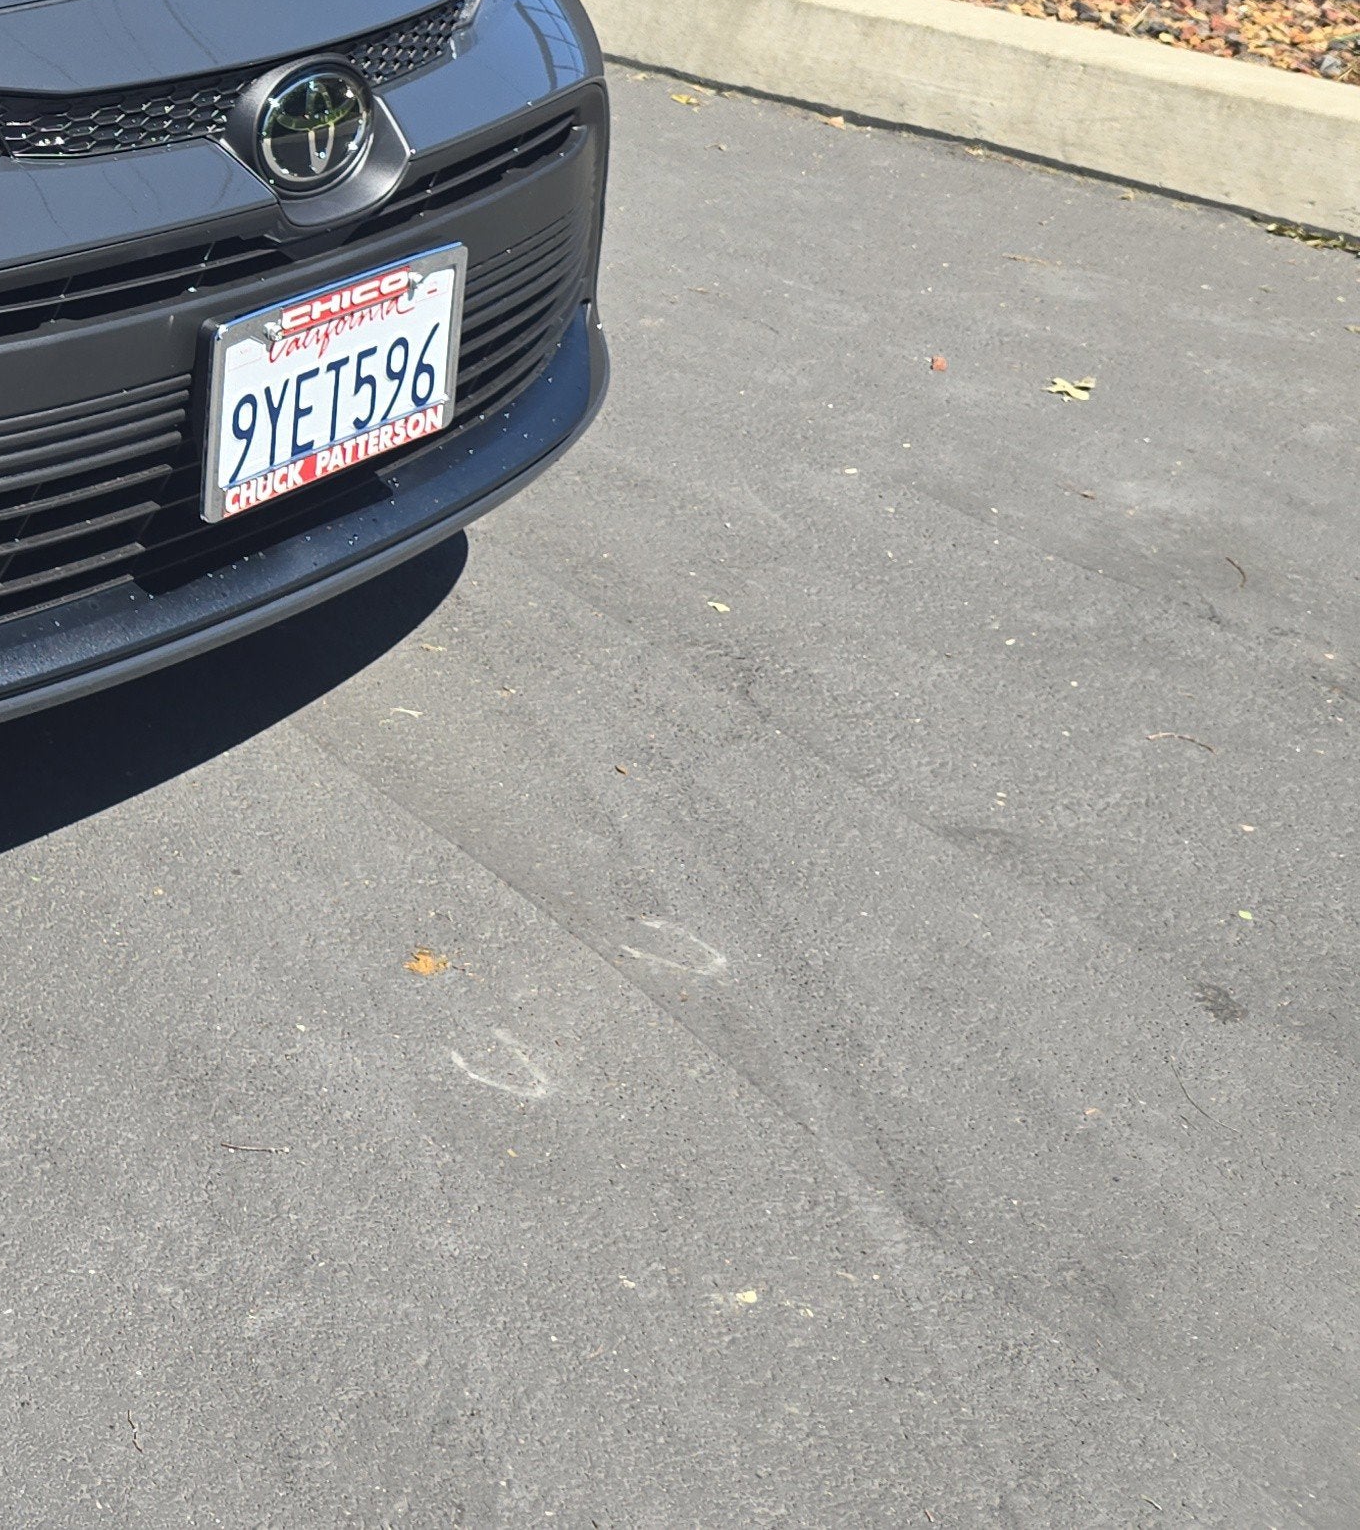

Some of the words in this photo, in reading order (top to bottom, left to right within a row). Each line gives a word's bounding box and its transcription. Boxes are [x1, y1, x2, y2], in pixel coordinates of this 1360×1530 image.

[269, 296, 415, 363] California
[281, 270, 411, 331] CHICO
[228, 322, 440, 484] 9YET596
[224, 458, 306, 514] CHUCK
[314, 406, 444, 478] PATTERSON
